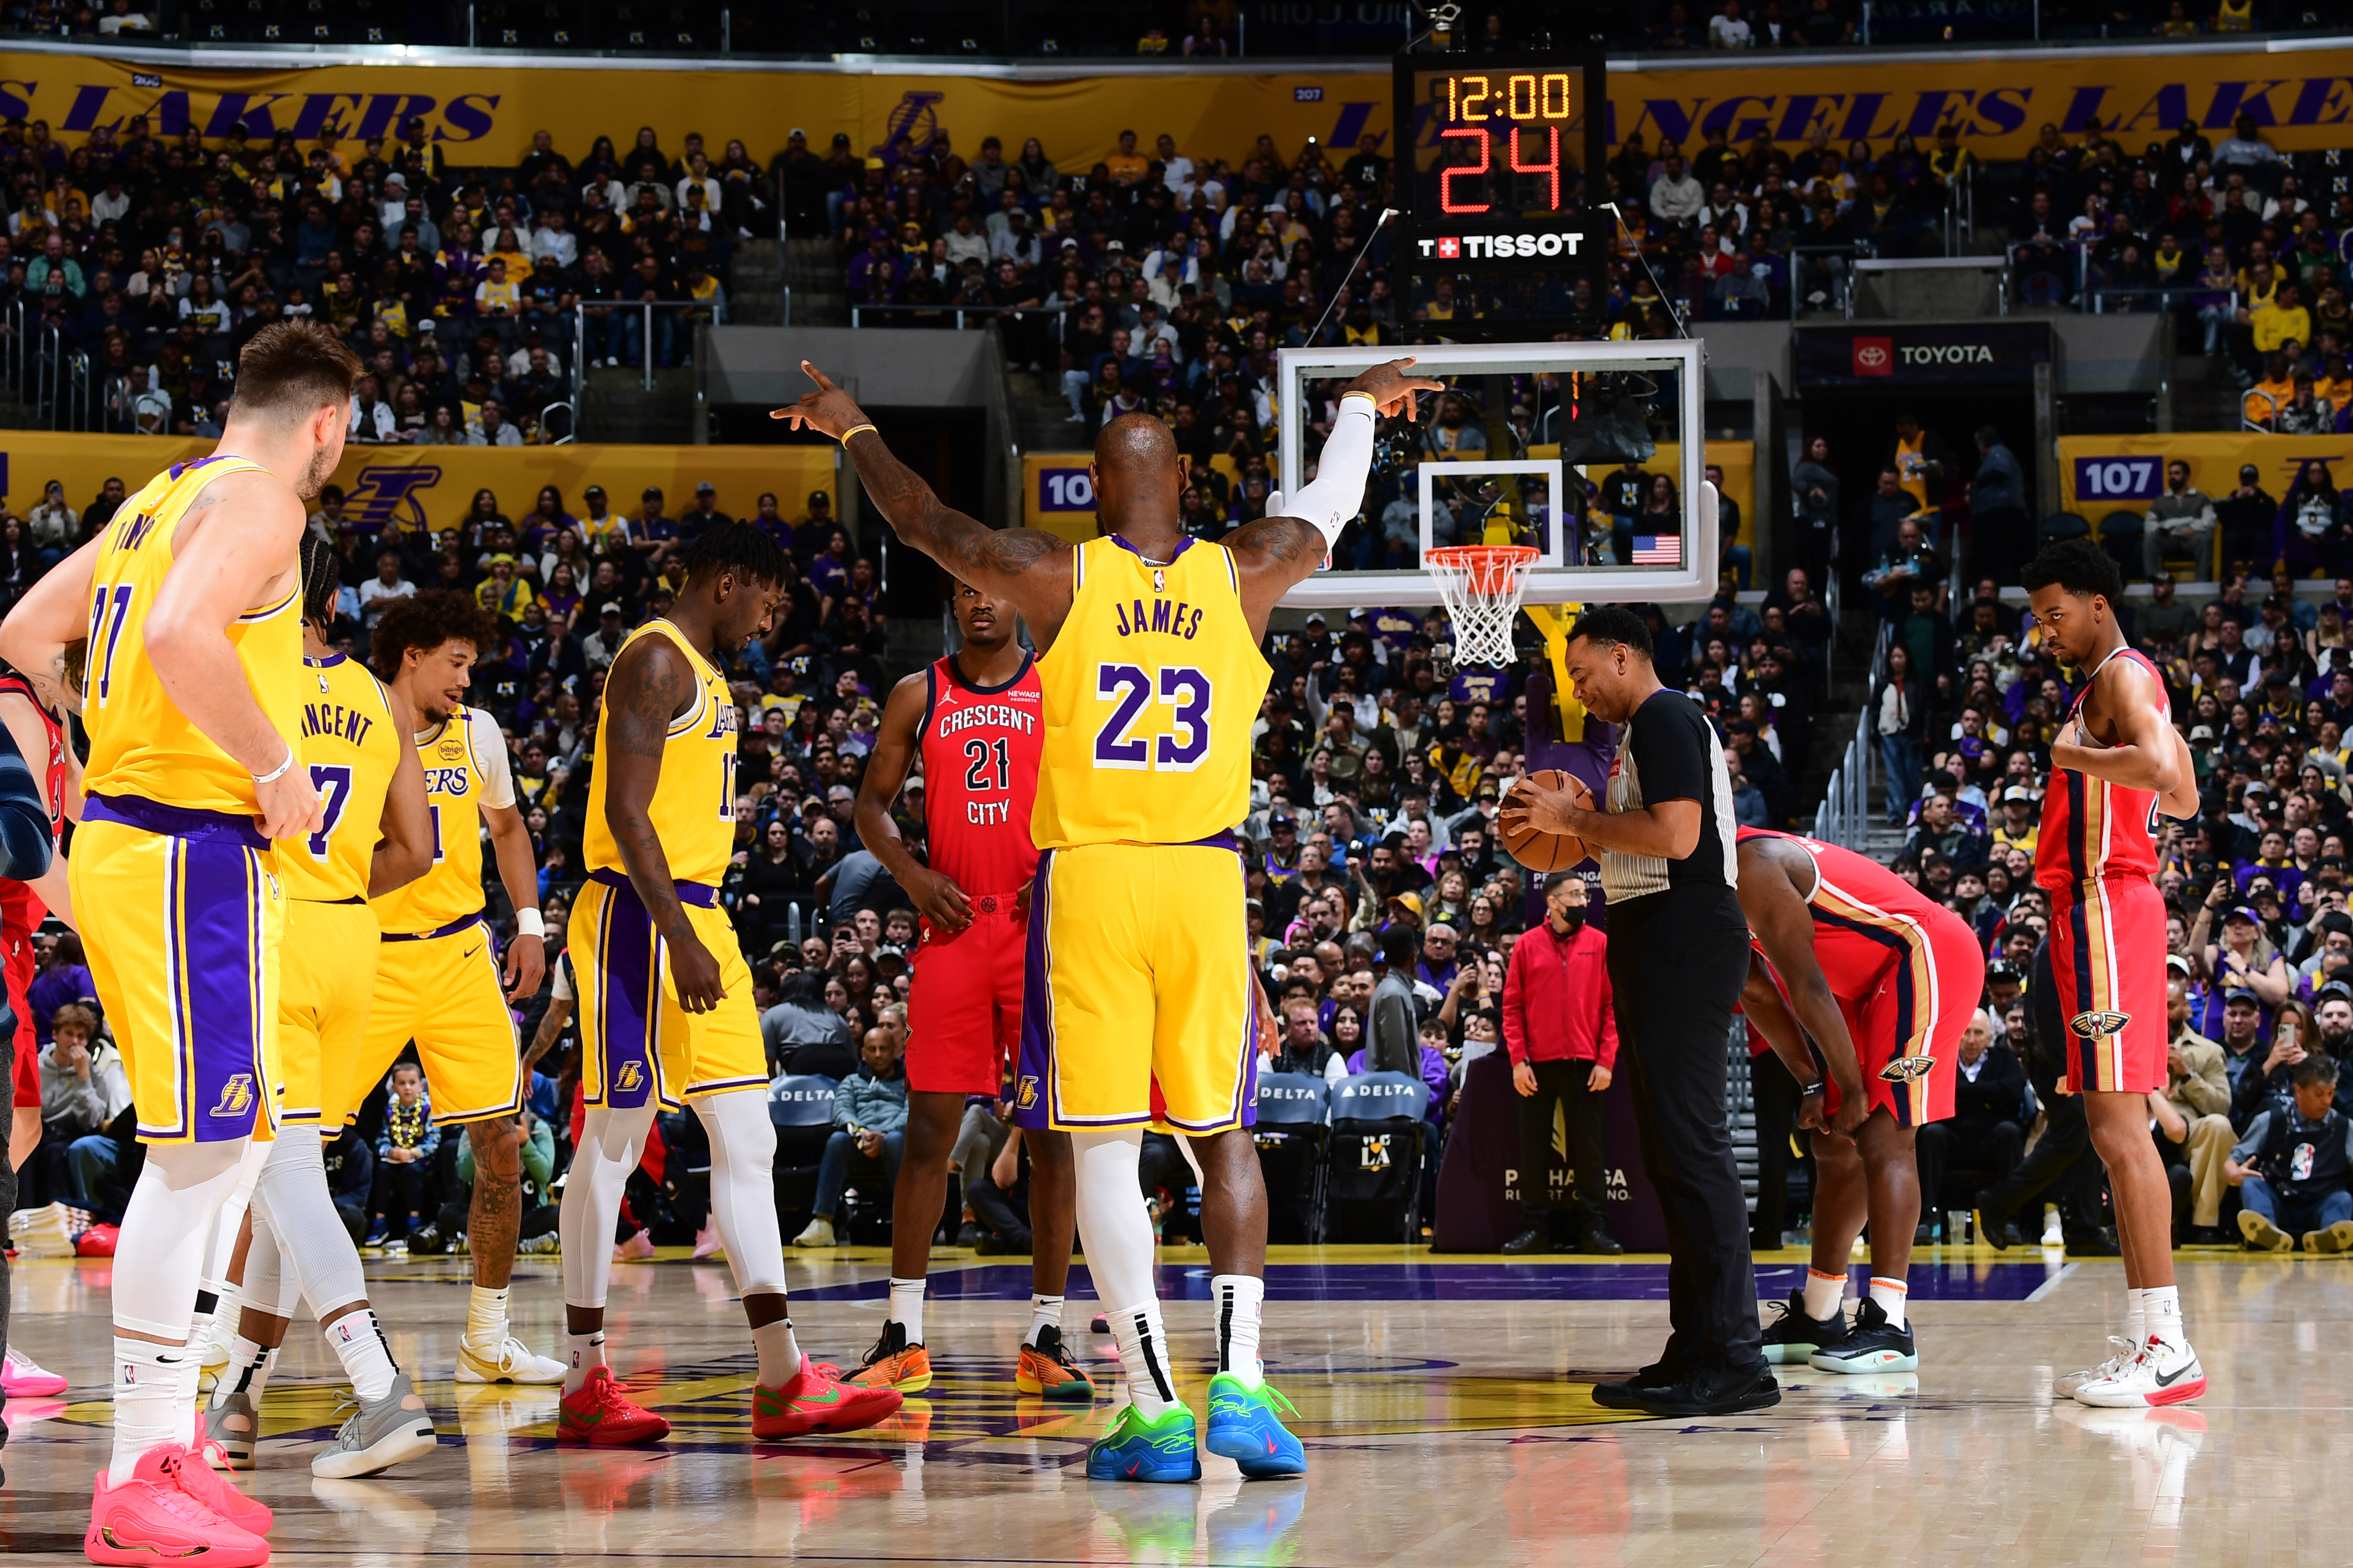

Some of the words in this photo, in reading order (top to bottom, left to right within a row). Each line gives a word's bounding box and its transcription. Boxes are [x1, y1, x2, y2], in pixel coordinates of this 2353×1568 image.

[1296, 89, 1322, 100] 207
[1448, 73, 1569, 122] 12:00
[57, 84, 501, 142] LAKERS
[1441, 126, 1560, 213] 24
[1462, 232, 1584, 258] TISSOT
[1901, 345, 1993, 364] TOYOTA
[1047, 474, 1092, 506] 10
[2086, 462, 2152, 495] 107
[1115, 598, 1203, 641] JAMES
[1008, 690, 1040, 699] NEWAGE
[301, 702, 373, 747] INCENT
[939, 705, 1035, 739] CRESCENT
[1093, 661, 1213, 772] 23
[440, 745, 463, 755] bibigo
[964, 737, 1010, 791] 21
[424, 766, 470, 797] ERS
[307, 762, 354, 863] 7
[967, 798, 1010, 826] CITY
[781, 1088, 836, 1102] DELTA
[1261, 1087, 1315, 1100] DELTA
[1360, 1084, 1414, 1097] DELTA
[1505, 1169, 1627, 1187] PHAA
[1572, 1189, 1629, 1201] CNO
